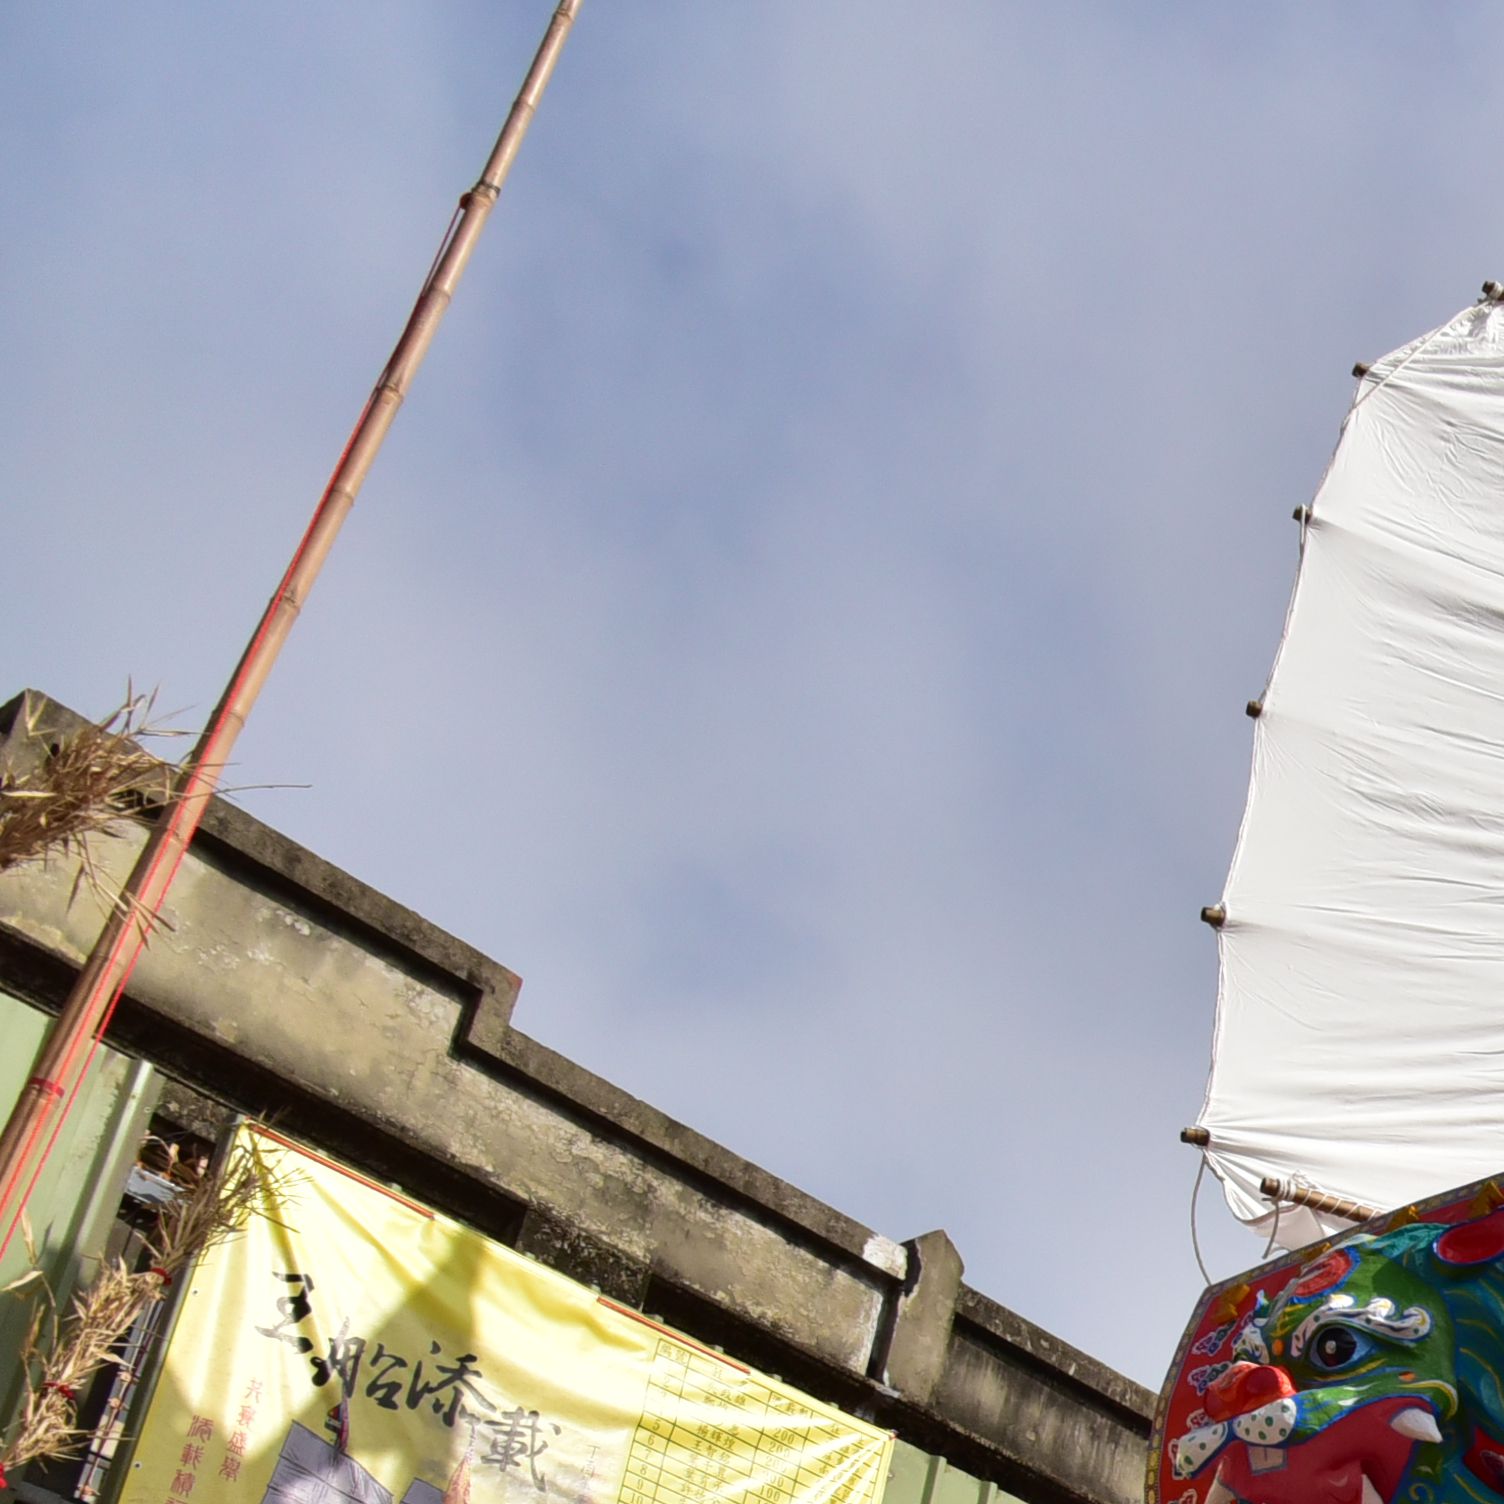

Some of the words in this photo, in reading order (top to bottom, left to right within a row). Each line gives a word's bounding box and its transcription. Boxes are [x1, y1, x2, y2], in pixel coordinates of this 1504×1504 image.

[651, 1420, 661, 1431] 5
[646, 1434, 656, 1446] 6
[640, 1464, 648, 1475] 8
[635, 1479, 644, 1490] 9
